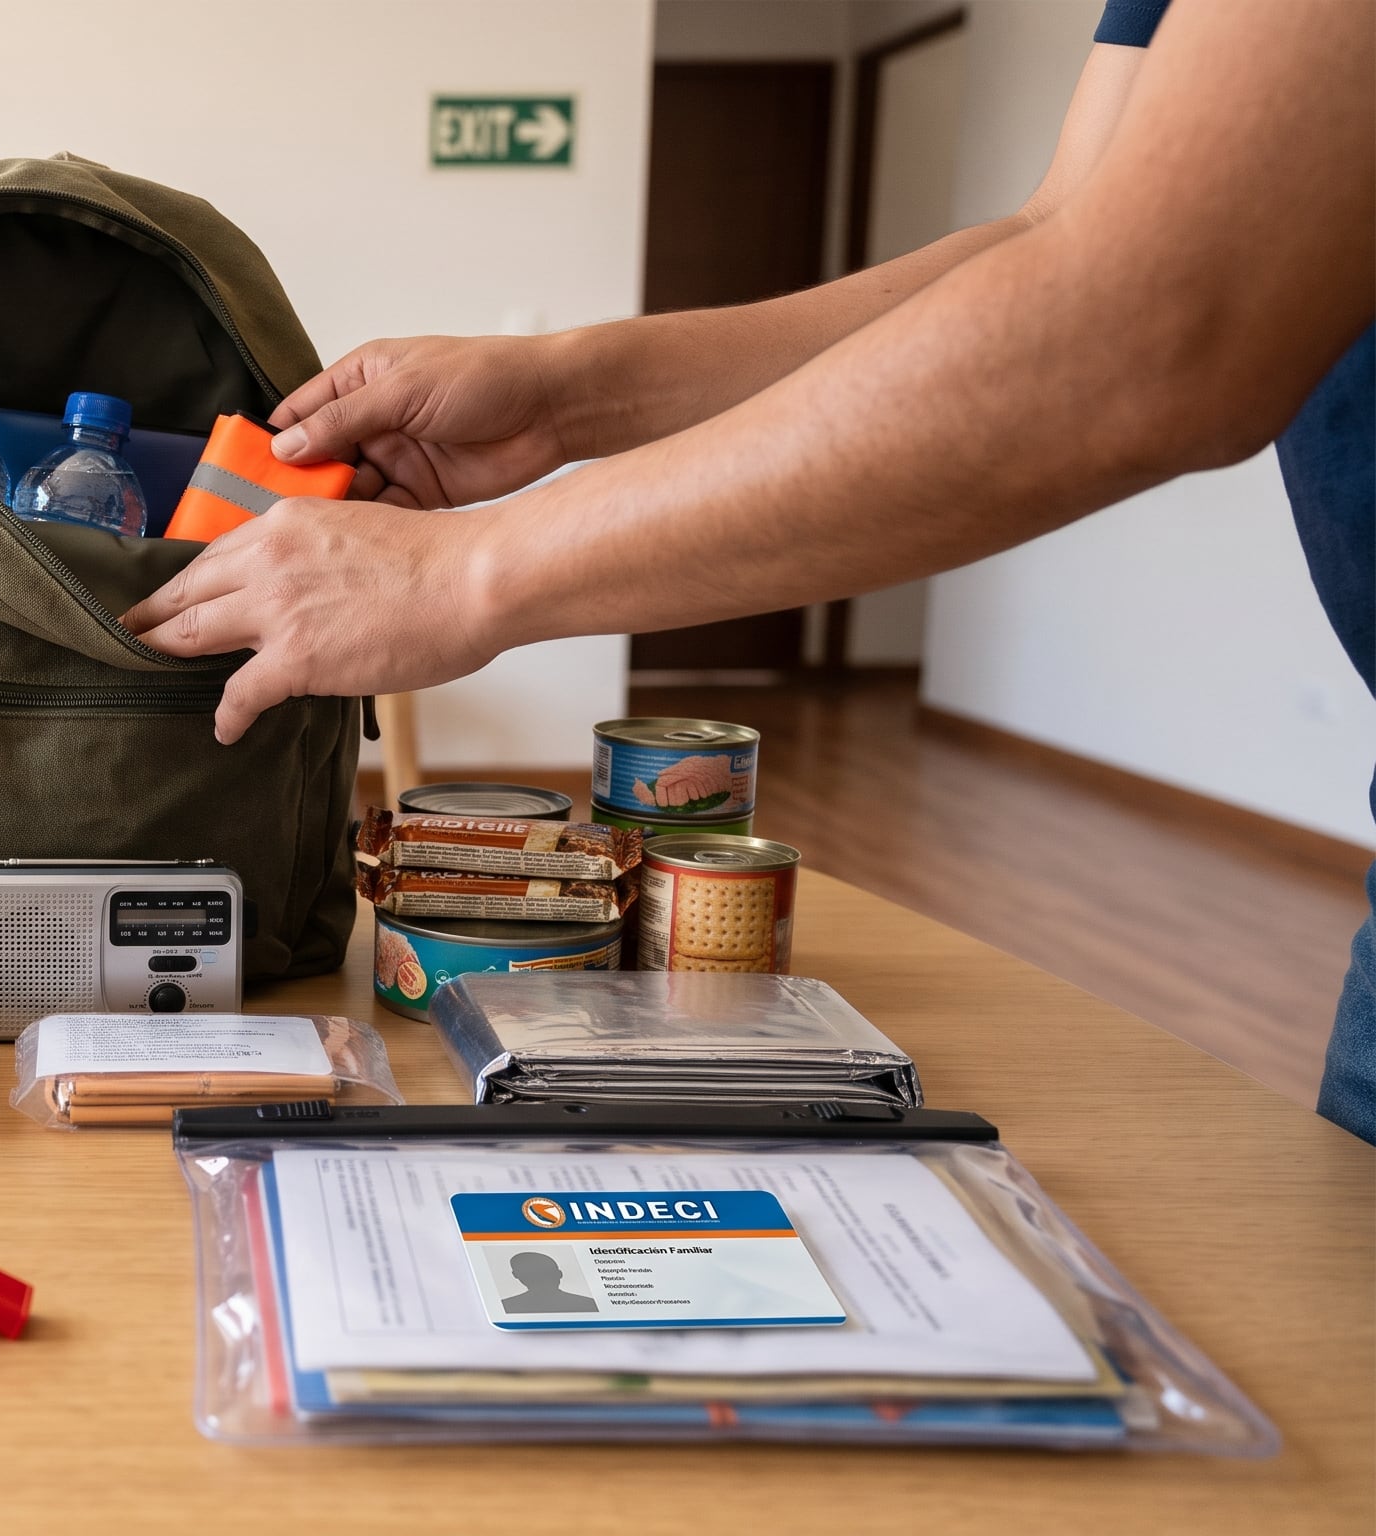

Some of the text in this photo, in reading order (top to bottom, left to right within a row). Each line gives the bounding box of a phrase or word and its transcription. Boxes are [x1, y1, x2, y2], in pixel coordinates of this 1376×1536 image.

[436, 105, 514, 158] EXIT
[569, 1200, 719, 1220] INDECI
[668, 1246, 713, 1255] Familiar
